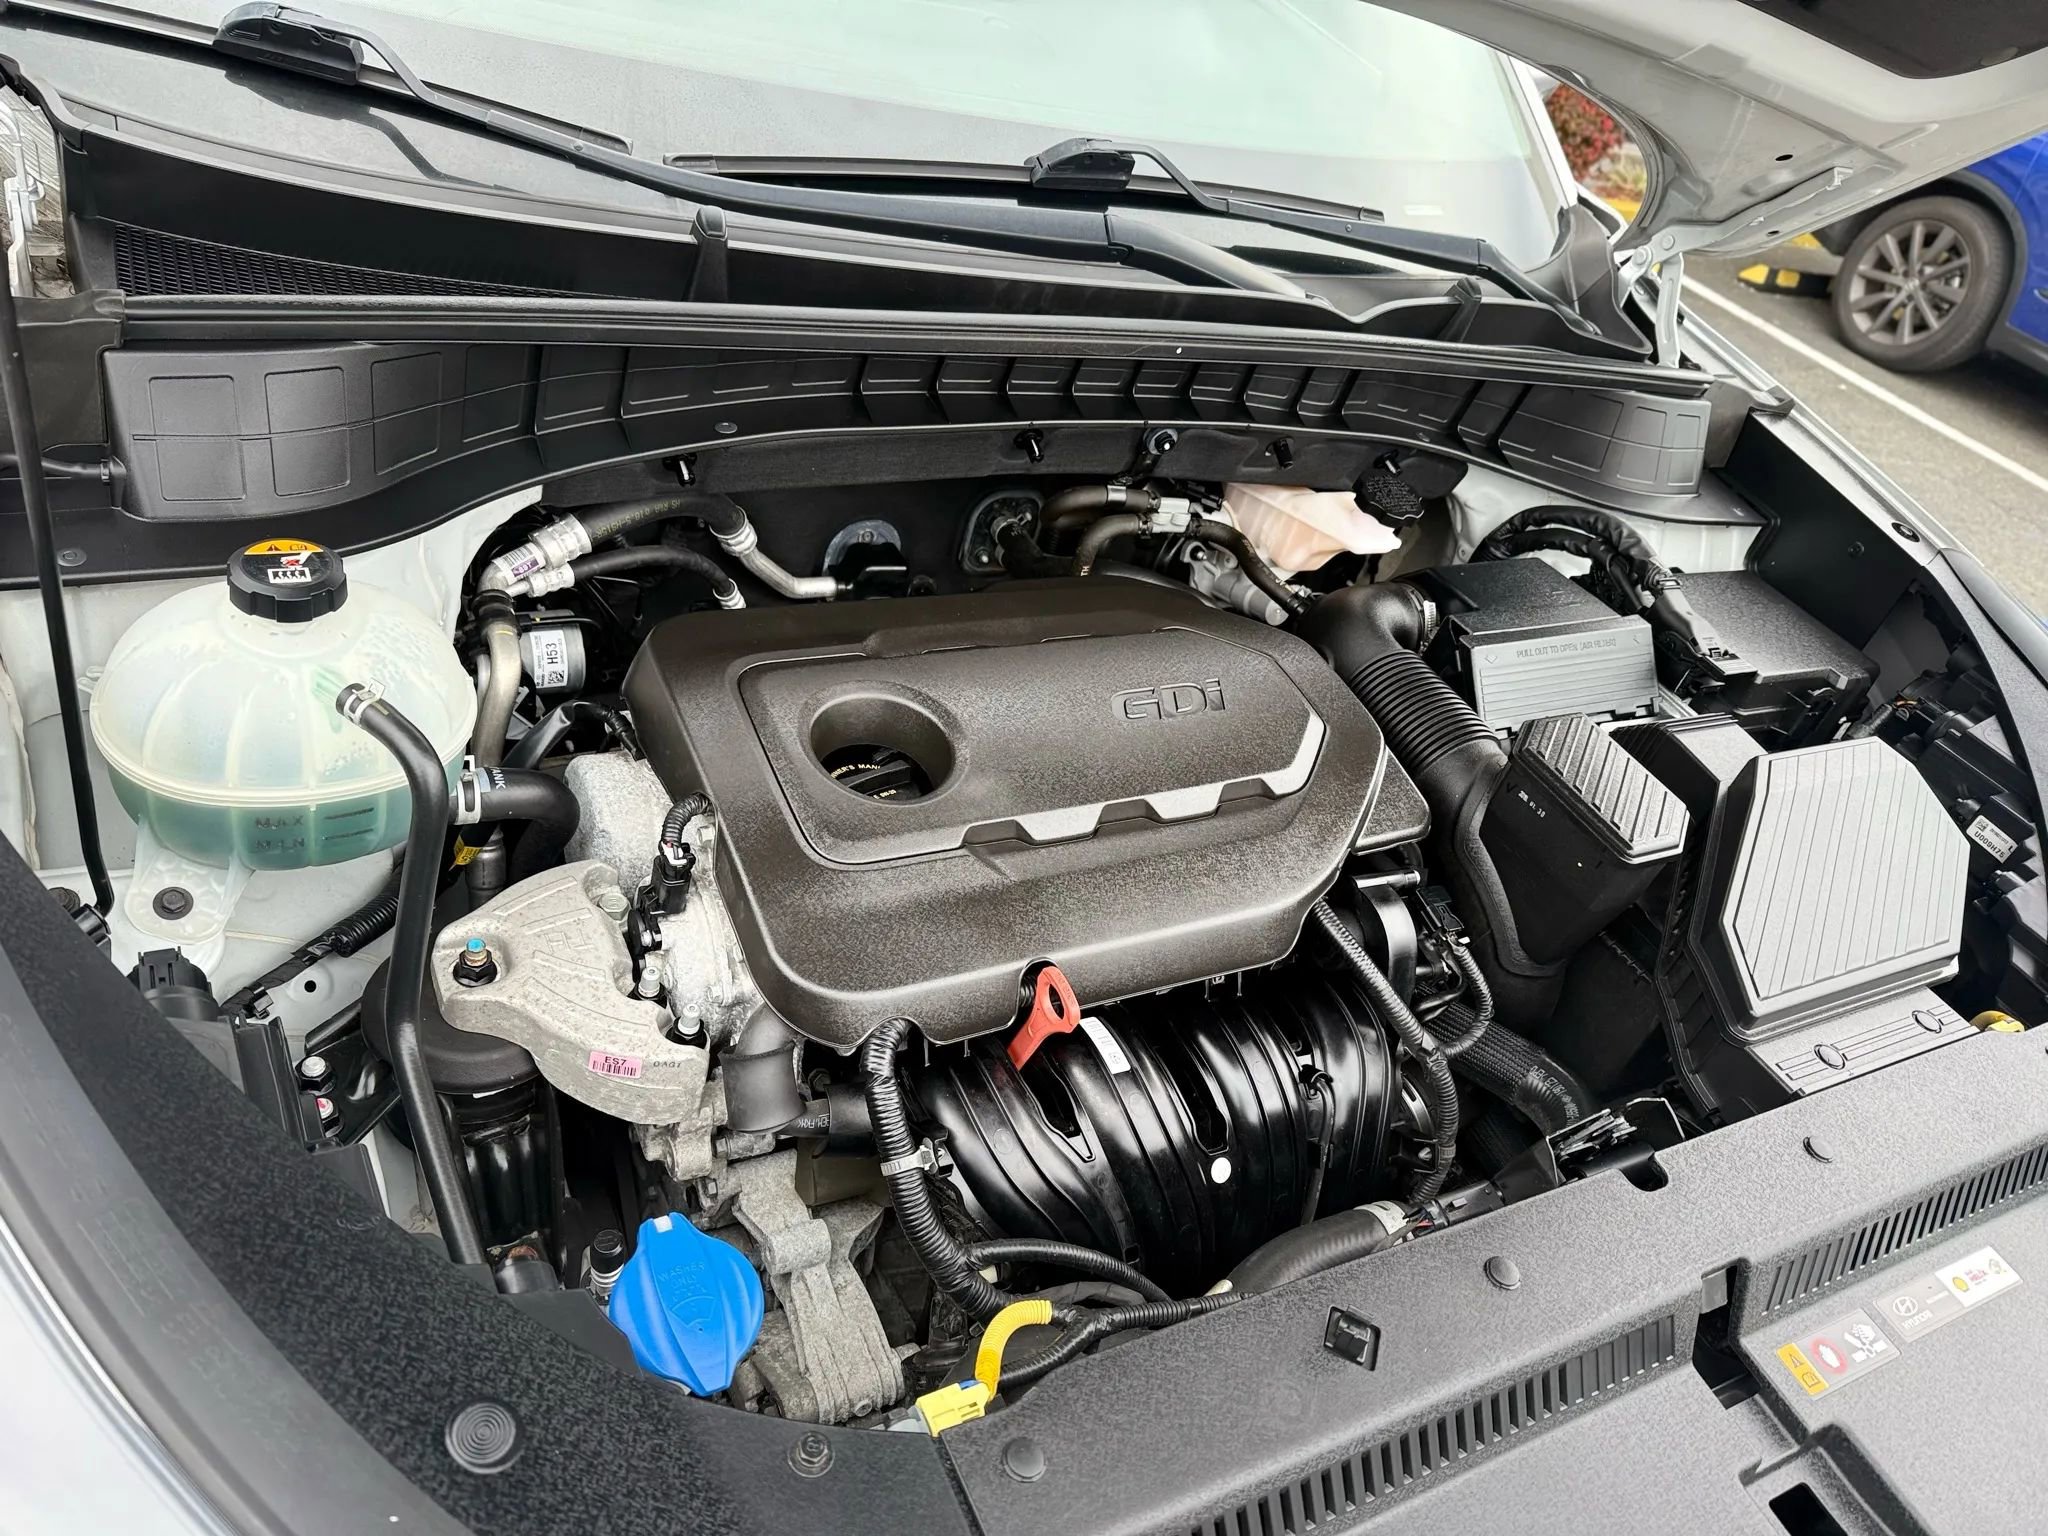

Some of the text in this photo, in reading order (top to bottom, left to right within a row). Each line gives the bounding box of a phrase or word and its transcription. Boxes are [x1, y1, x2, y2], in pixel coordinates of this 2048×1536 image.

[545, 642, 559, 665] H53
[1516, 648, 1534, 659] PULL
[1534, 646, 1549, 656] OUT
[1549, 645, 1560, 654] TO
[1560, 642, 1578, 653] OPEN
[1111, 678, 1226, 721] GDi
[604, 1055, 627, 1066] ES7
[657, 1261, 705, 1282] WASHER
